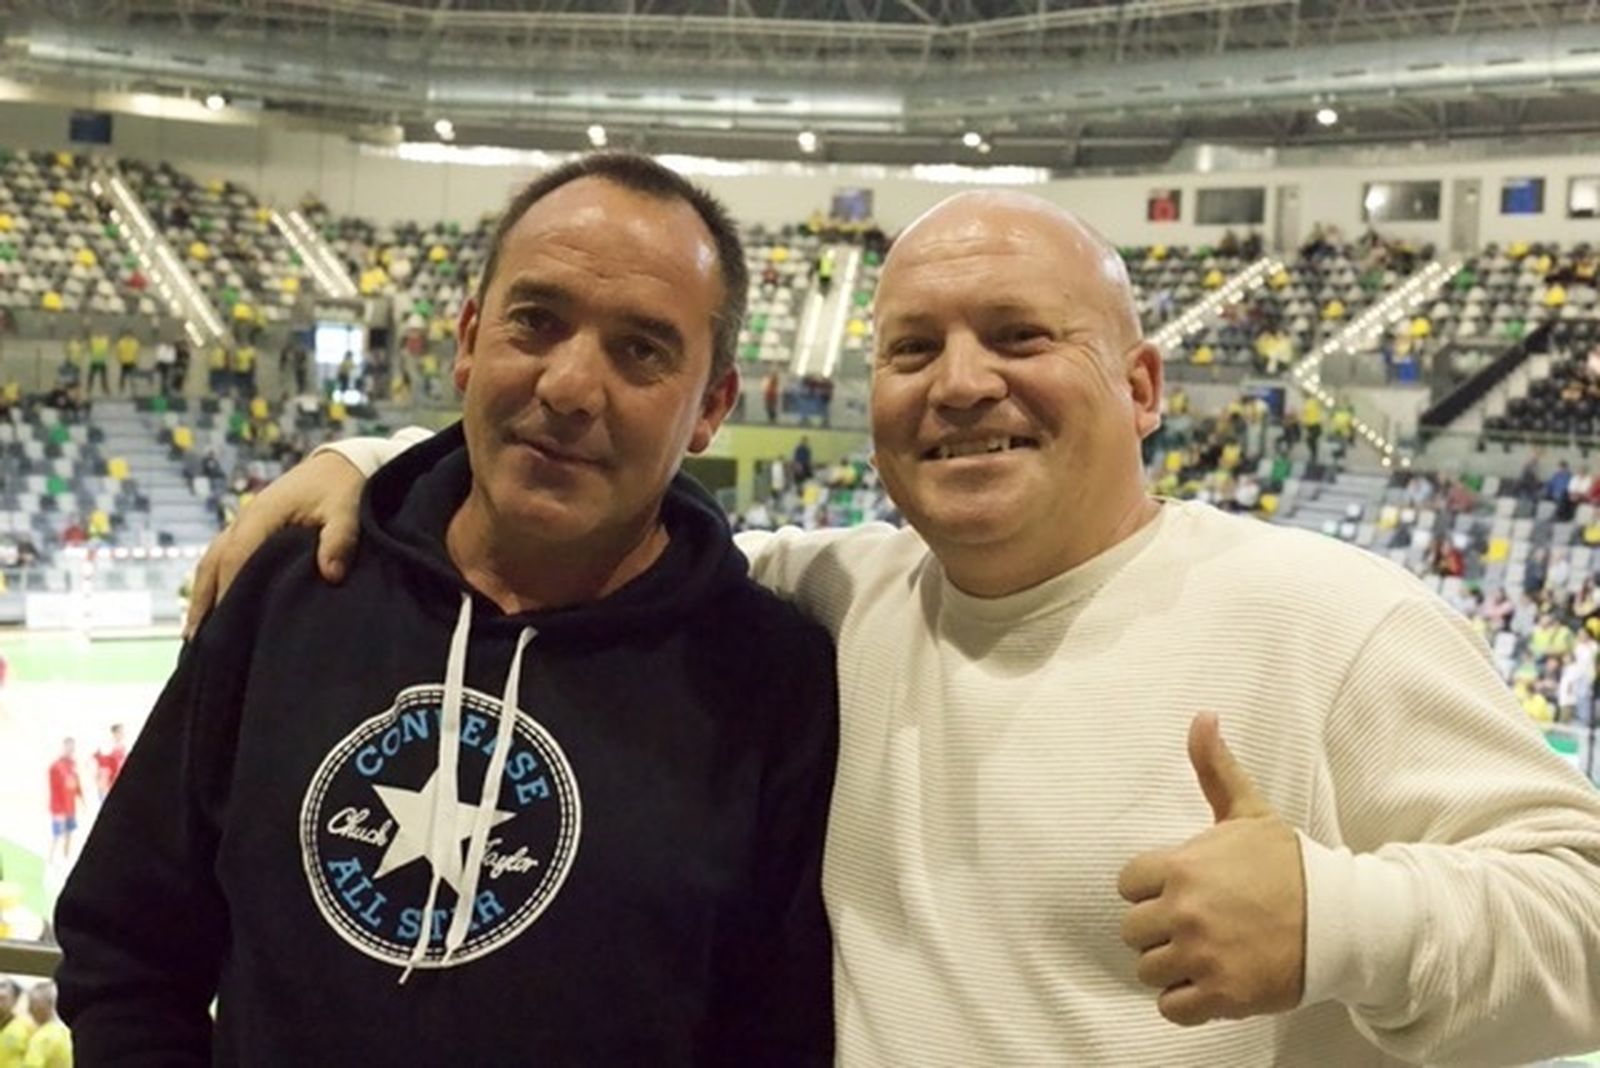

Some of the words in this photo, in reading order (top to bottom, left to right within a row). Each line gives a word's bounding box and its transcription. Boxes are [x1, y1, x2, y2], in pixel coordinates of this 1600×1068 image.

[355, 708, 549, 804] CONESE
[327, 857, 387, 927] ALL
[397, 890, 504, 939] STR
